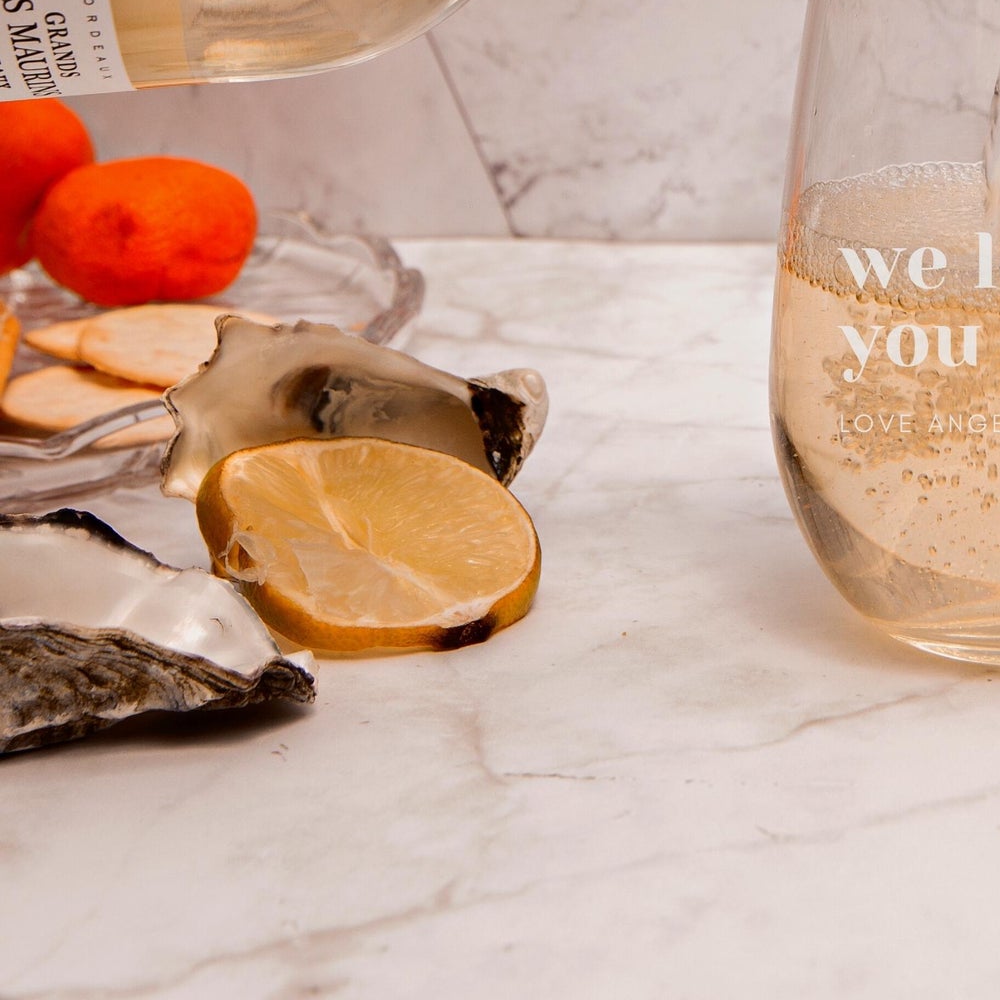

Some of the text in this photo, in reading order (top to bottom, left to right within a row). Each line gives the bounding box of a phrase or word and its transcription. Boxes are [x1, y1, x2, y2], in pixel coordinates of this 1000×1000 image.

[44, 11, 81, 79] GRANDS
[837, 245, 948, 290] we
[837, 323, 982, 383] you
[839, 413, 913, 434] LOVE
